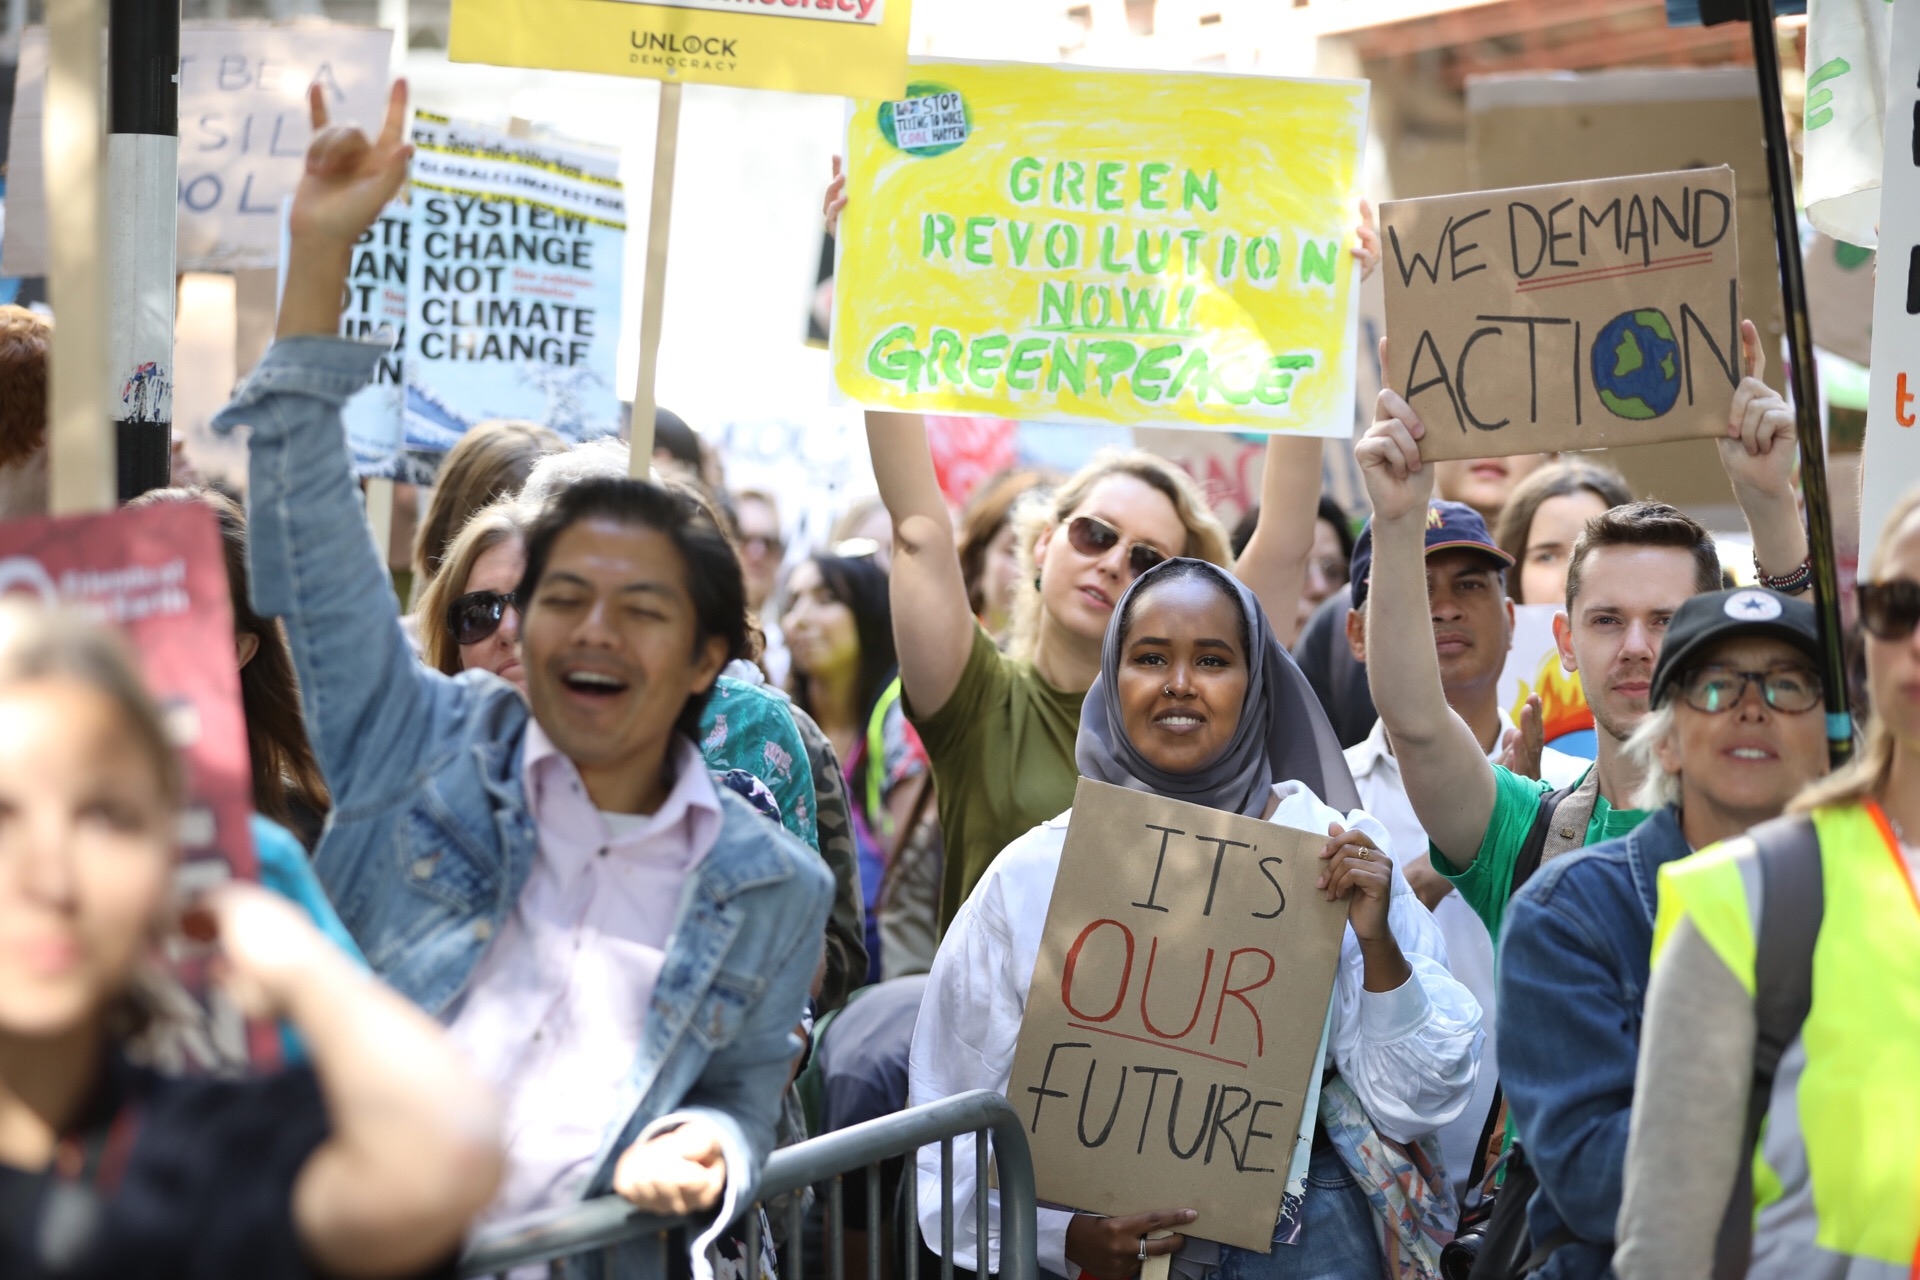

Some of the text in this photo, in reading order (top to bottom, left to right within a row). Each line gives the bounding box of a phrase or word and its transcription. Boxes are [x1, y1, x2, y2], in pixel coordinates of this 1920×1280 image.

[630, 54, 737, 71] DEMOCRACY
[631, 30, 738, 57] UNLOCK
[922, 93, 959, 114] STOP
[1009, 157, 1218, 211] GREEN
[425, 197, 587, 235] SYSTEM
[1388, 187, 1731, 288] WE DEMAND
[424, 231, 593, 270] CHANGE
[922, 213, 1337, 285] REVOLUTION
[424, 264, 505, 294] NOT
[422, 298, 595, 338] CLIMATE
[1041, 280, 1195, 331] NOW!
[420, 332, 590, 368] CHANGE
[868, 325, 1315, 405] GREENPEACE
[1404, 279, 1741, 433] ACTION
[1132, 824, 1286, 919] IT'S
[1061, 919, 1276, 1057] OUR
[1027, 1043, 1283, 1173] FUTURE
